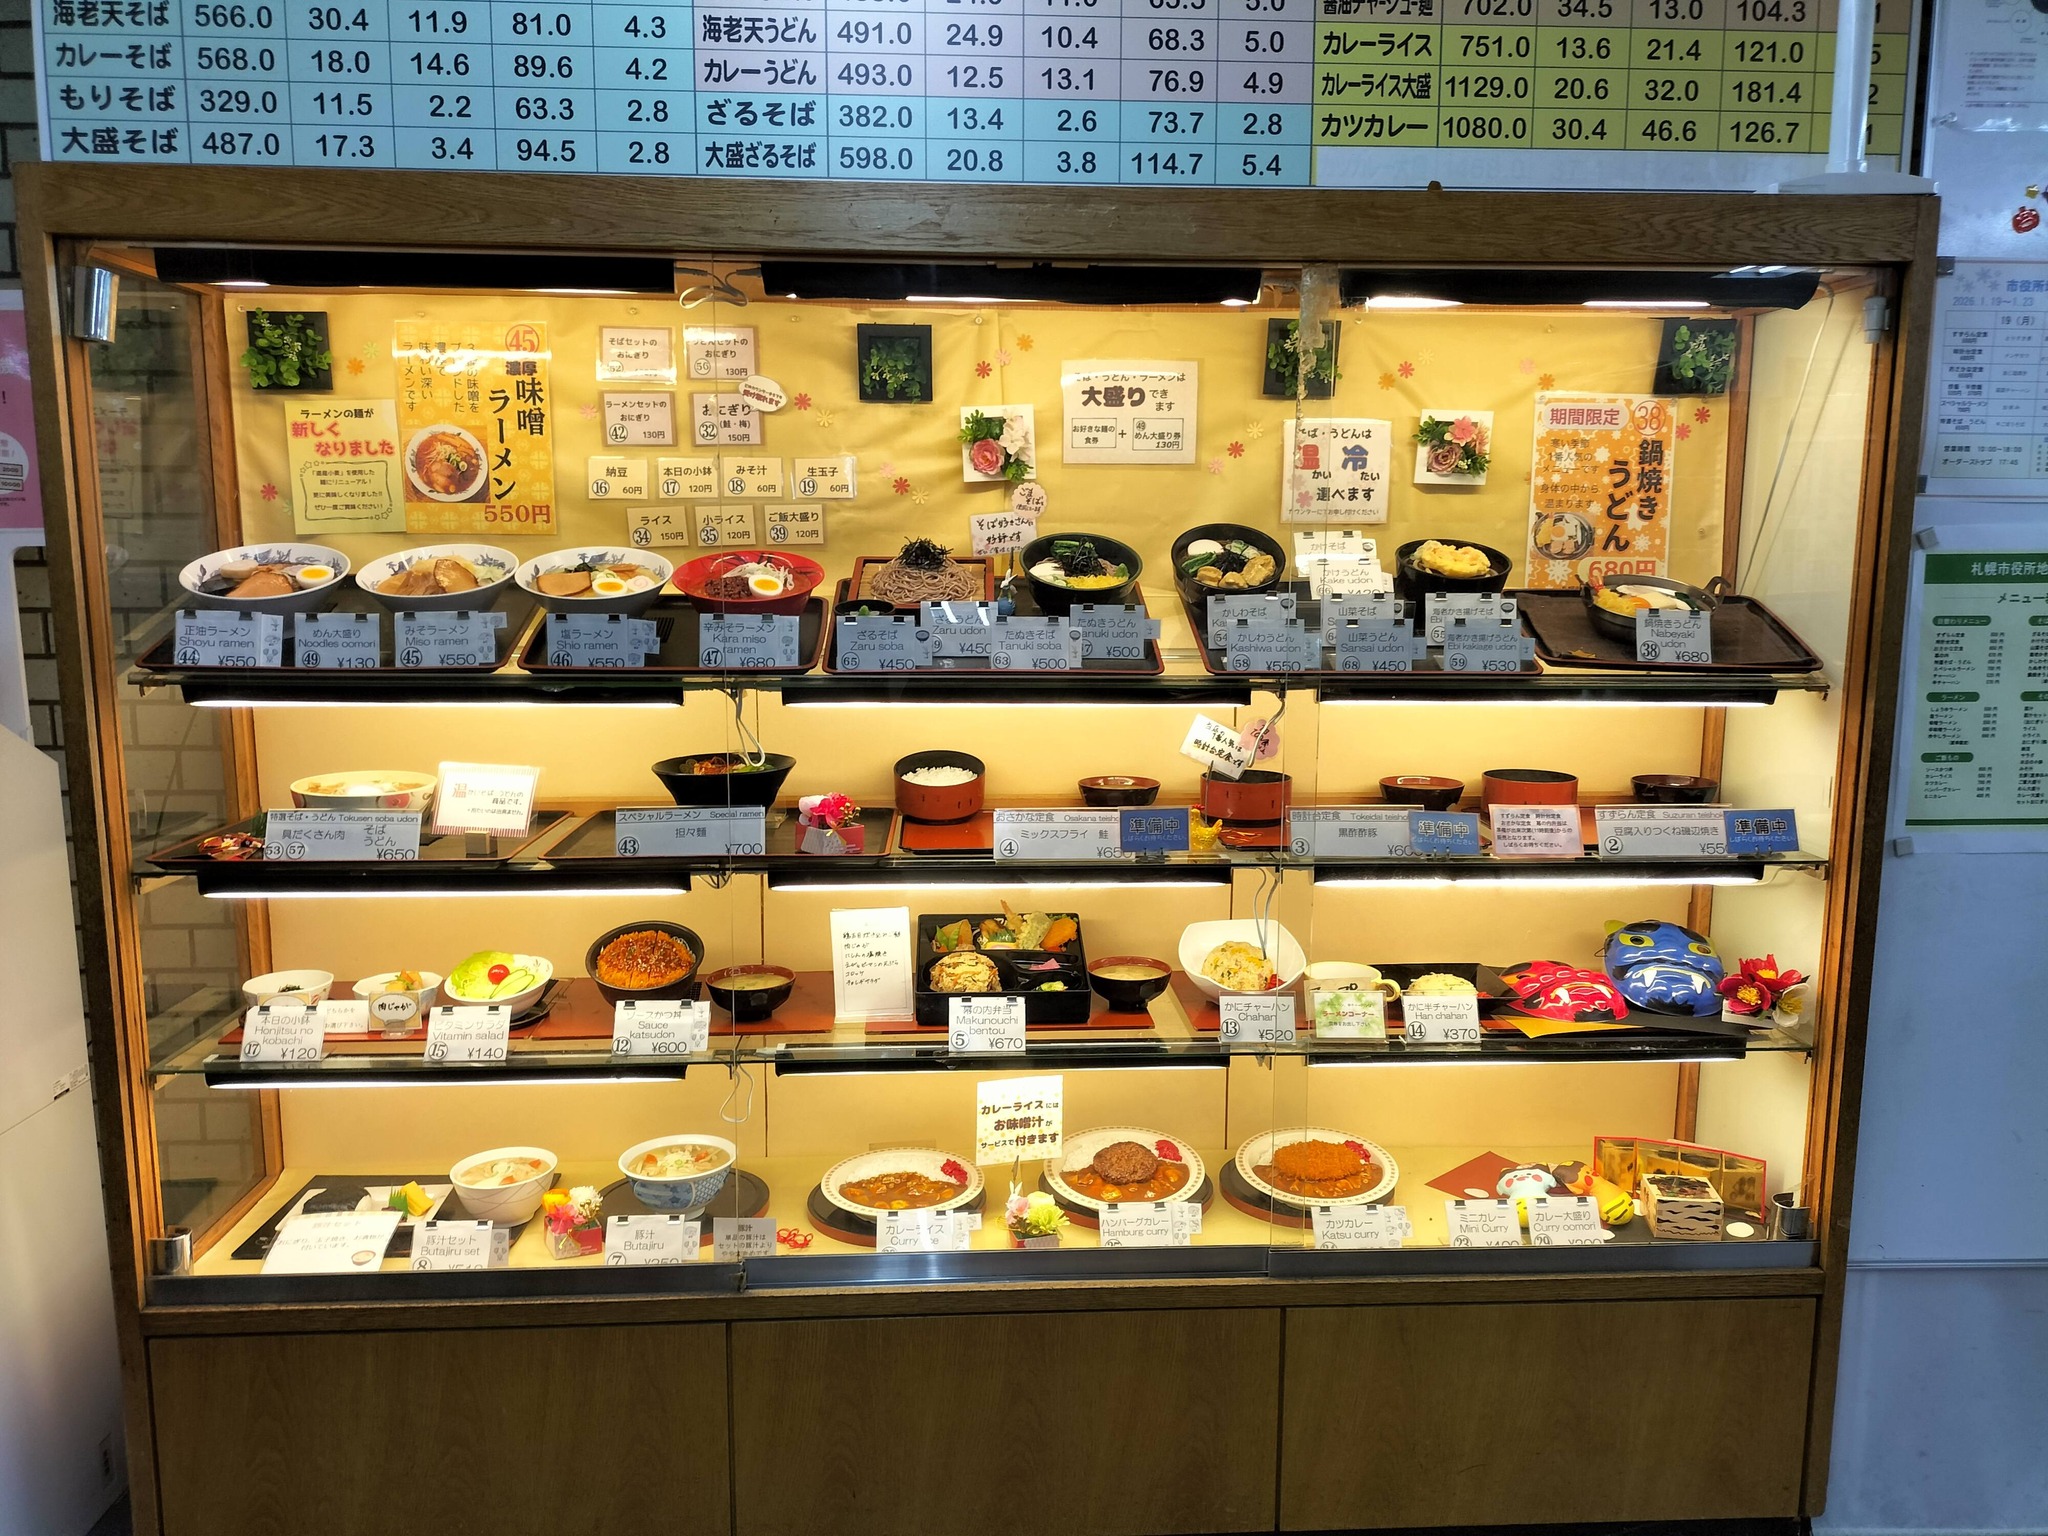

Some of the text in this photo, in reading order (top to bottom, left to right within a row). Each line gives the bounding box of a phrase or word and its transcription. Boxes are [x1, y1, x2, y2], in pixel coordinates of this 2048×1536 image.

[53, 0, 666, 39] 海老天そば 566.0 30.4 11.9 81.0 4.3
[704, 59, 1284, 95] カレーうどん 493.0 12.5 13.1 76.9 4.9
[1320, 114, 1800, 145] カツカレー 1080.0 30.4 46.6 126.7
[61, 127, 670, 166] 大盛そば 487.0 17.3 3.4 94.5 2.8
[705, 143, 1282, 178] 大盛ざるそば 598.0 20.8 3.8 114.7 5.4
[608, 338, 658, 346] そばセットの
[505, 361, 538, 376] 濃厚
[1081, 386, 1168, 407] 大盛り でき
[606, 400, 667, 409] ラーメンセットの
[1155, 401, 1175, 411] ます
[620, 413, 650, 422] おにぎり
[1550, 408, 1620, 426] 期間限定
[1637, 405, 1662, 431] 38
[291, 421, 341, 437] 新しく
[643, 430, 665, 439] 130円
[728, 433, 750, 442] 150円
[488, 388, 516, 500] ラーメン
[1084, 436, 1099, 445] 食券
[1155, 440, 1180, 449] 130円
[315, 440, 395, 456] なりました
[1342, 444, 1368, 471] 冷
[605, 467, 628, 478] 納豆
[663, 467, 712, 477] 本日の小鉢
[736, 465, 767, 475] みそ汁
[807, 467, 839, 477] 生玉子
[1636, 440, 1663, 520] 鍋焼き
[622, 486, 643, 495] 60円
[689, 484, 712, 493] 120円
[757, 484, 777, 493] 60円
[829, 484, 849, 493] 60円
[1540, 484, 1599, 494] 身体の中から
[1316, 487, 1374, 501] 選べます
[1545, 499, 1593, 509] 温まります
[1603, 460, 1634, 552] うどん
[484, 504, 550, 524] 550円
[768, 512, 819, 523] ご飯大盛り
[640, 515, 672, 525] ライス
[702, 514, 745, 525] 小ライス
[660, 531, 684, 541] 150円
[727, 530, 750, 540] 120円
[795, 529, 819, 538] 120円
[703, 623, 776, 633] 辛みそラーメン
[1644, 619, 1701, 628] 鍋焼きうどん
[184, 625, 250, 637] 正油ラーメン
[312, 628, 361, 638] めん大盛り
[405, 625, 469, 636] みそラーメン
[857, 630, 898, 641] ざるそば
[1005, 630, 1055, 640] たぬきそば
[1651, 629, 1695, 639] Nabeyaki
[179, 637, 255, 648] Shoyu ramen
[406, 637, 469, 646] Miso ramen
[712, 634, 767, 644] Kara miso
[1238, 633, 1294, 642] かしわうどん
[1348, 633, 1398, 642] 山菜うどん
[298, 639, 376, 648] Noodles oomori
[850, 641, 904, 650] Zaru soba
[998, 641, 1062, 650] Tanuki soba
[1230, 644, 1301, 653] Kashiwa udon
[1341, 644, 1404, 653] Sansai udon
[1661, 640, 1686, 648] udon
[722, 646, 757, 654] ramen
[218, 655, 256, 667] ¥550
[439, 653, 476, 665] ¥550
[1675, 651, 1709, 662] ¥680
[739, 657, 776, 667] ¥680
[879, 659, 915, 670] ¥450
[1032, 658, 1067, 669] ¥500
[1373, 661, 1406, 671] ¥450
[619, 811, 700, 822] スペシャルラーメン
[710, 811, 737, 819] Special
[1130, 818, 1180, 833] 準備中
[1419, 821, 1469, 838] 準備中
[1735, 819, 1787, 834] 準備中
[282, 829, 345, 840] 具だくさん肉
[1021, 829, 1088, 839] ミックスフライ
[1614, 826, 1719, 836] 豆腐入りつくね磯辺焼き
[725, 843, 763, 855] ¥700
[1224, 1002, 1290, 1012] かにチャーハン
[1408, 1002, 1473, 1012] かに半チャーハン
[956, 1016, 1018, 1025] Makunouchi
[1238, 1012, 1277, 1022] Chahan
[1415, 1011, 1468, 1020] Han chahan
[638, 1021, 668, 1029] Sauce
[630, 1031, 675, 1039] katsudon
[969, 1026, 1005, 1035] bentou
[1258, 1029, 1294, 1041] ¥520
[1443, 1028, 1478, 1040] ¥370
[433, 1031, 504, 1041] Vitamin salad
[652, 1041, 687, 1054] ¥600
[988, 1038, 1023, 1049] ¥670
[467, 1047, 503, 1060] ¥140
[1535, 1211, 1591, 1221] カレー大盛り
[1326, 1219, 1373, 1229] カツカレー
[1460, 1223, 1508, 1233] Mini Curry
[1102, 1228, 1169, 1237] Hamburg curry
[1322, 1230, 1379, 1240] Katsu curry
[426, 1234, 476, 1245] 豚汁セット
[421, 1246, 480, 1257] Butajiru set
